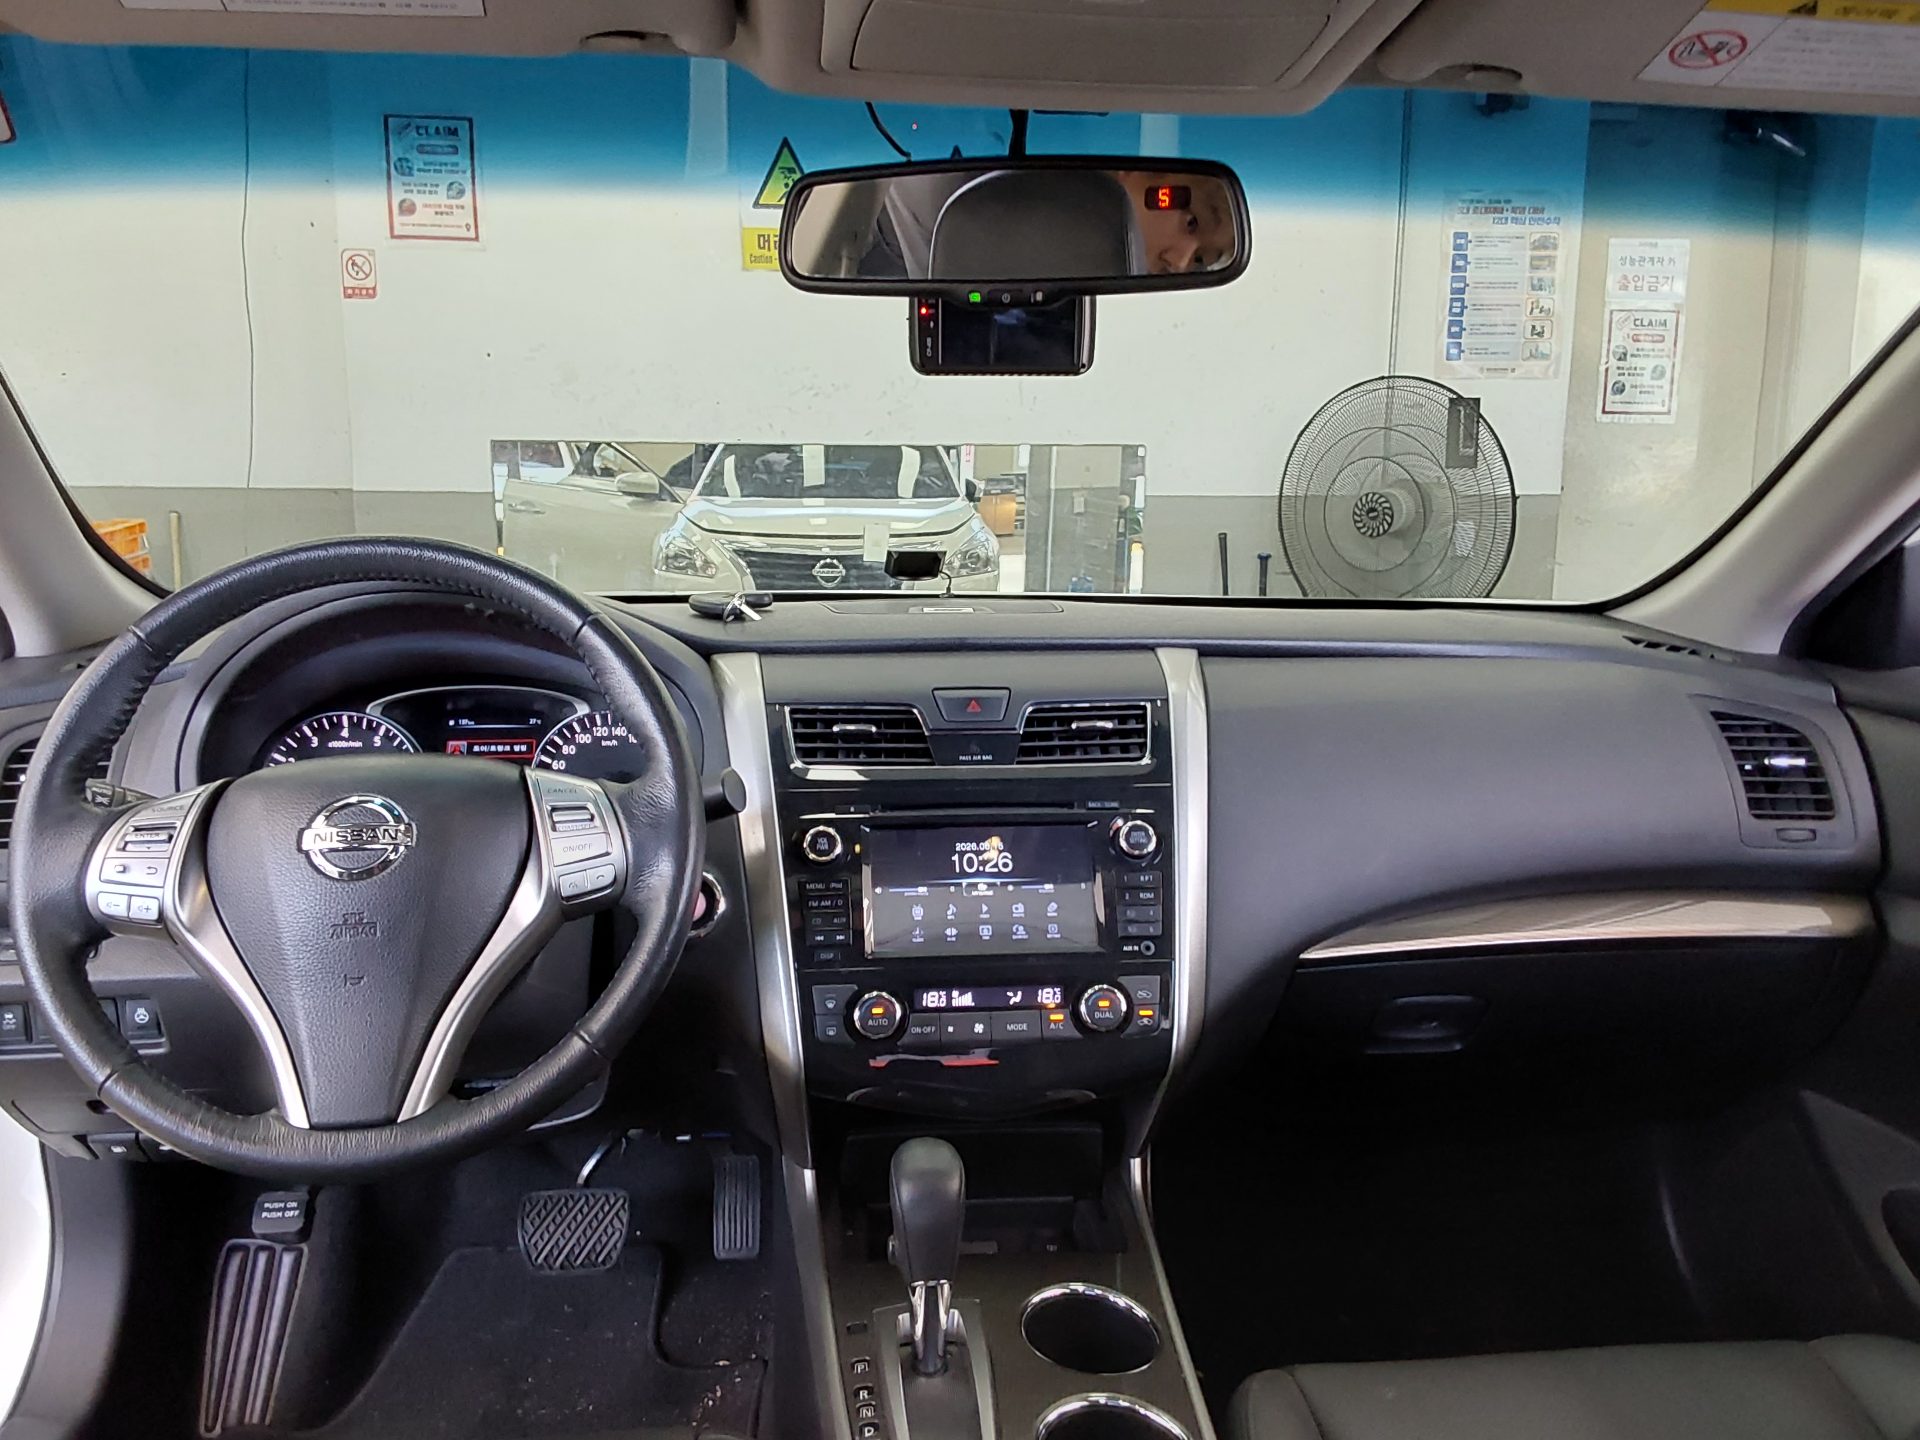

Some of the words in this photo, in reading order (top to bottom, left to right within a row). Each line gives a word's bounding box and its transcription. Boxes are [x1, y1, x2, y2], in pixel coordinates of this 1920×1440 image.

[415, 125, 459, 137] CLAIM
[1619, 255, 1665, 267] 성능관계자
[1616, 274, 1675, 292] 출입금지
[1633, 318, 1668, 329] CLAIM
[340, 727, 349, 738] 4
[593, 726, 609, 737] 120
[611, 726, 627, 737] 140
[311, 736, 319, 747] 3
[373, 735, 381, 747] 5
[575, 734, 592, 744] 100
[562, 745, 576, 755] 80
[552, 760, 566, 770] 60
[314, 828, 399, 845] NISSAN
[562, 843, 593, 853] ON/OFF
[951, 852, 1013, 873] 10:26
[806, 882, 826, 890] MENU
[329, 924, 379, 939] AIRBAG
[1094, 1011, 1114, 1019] DUAL
[867, 1018, 888, 1026] AUTO
[1006, 1023, 1028, 1031] MODE
[1050, 1022, 1064, 1030] A/C
[284, 1210, 300, 1218] OFF
[857, 1364, 865, 1374] P
[860, 1389, 869, 1400] R
[863, 1408, 872, 1418] N
[865, 1426, 875, 1437] D
